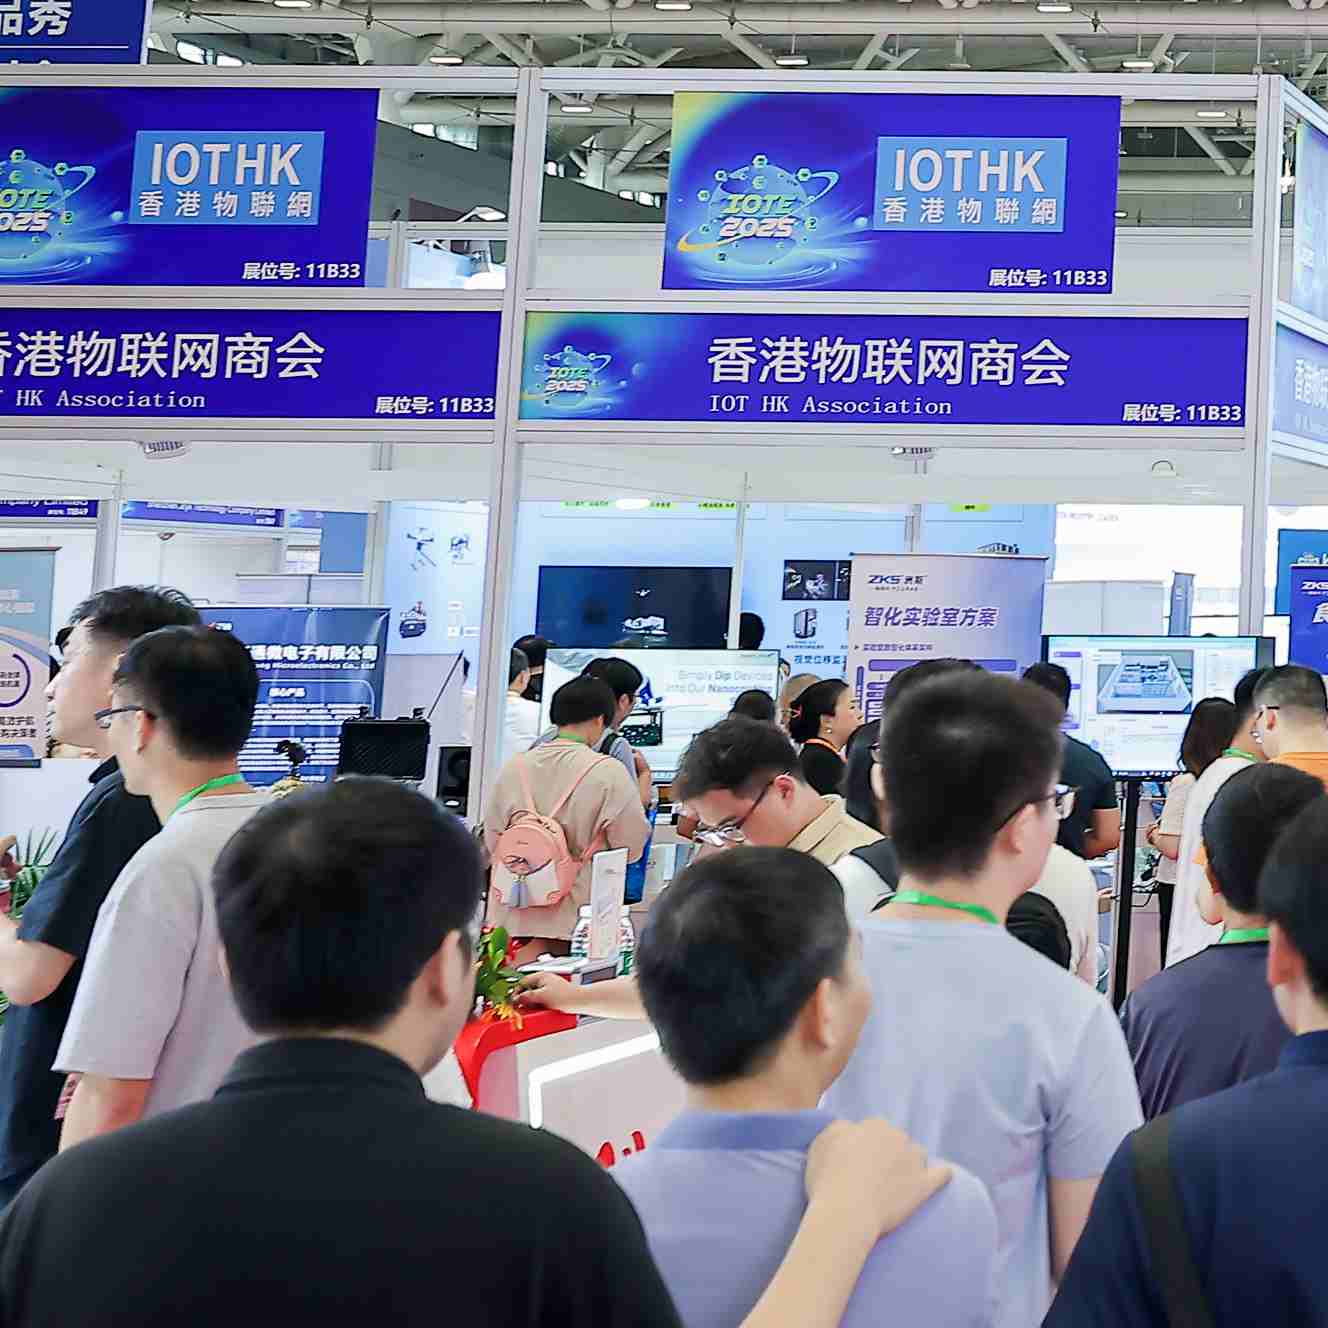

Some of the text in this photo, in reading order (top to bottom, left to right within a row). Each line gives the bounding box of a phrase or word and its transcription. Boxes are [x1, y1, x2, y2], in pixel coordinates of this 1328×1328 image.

[150, 143, 303, 185] IOTHK
[894, 149, 1045, 193] IOTHK
[0, 188, 53, 209] OTE
[139, 192, 312, 217] 香港物聯網
[724, 193, 795, 215] IOTE
[882, 197, 1057, 224] 香港物聯網
[0, 212, 51, 232] 025
[719, 216, 797, 238] 2025
[242, 263, 360, 280] 展位号: 11B33
[989, 269, 1107, 287] 展位号: 11B33
[0, 331, 326, 379] 港物联网商会
[708, 336, 1072, 387] 香港物联网商会
[16, 390, 206, 408] HK Association
[375, 396, 494, 414] 展位号: 11B33
[710, 396, 952, 416] IOT HK Association
[1122, 403, 1241, 423] 展位号: 11B33
[864, 607, 998, 628] 智化实验室方案
